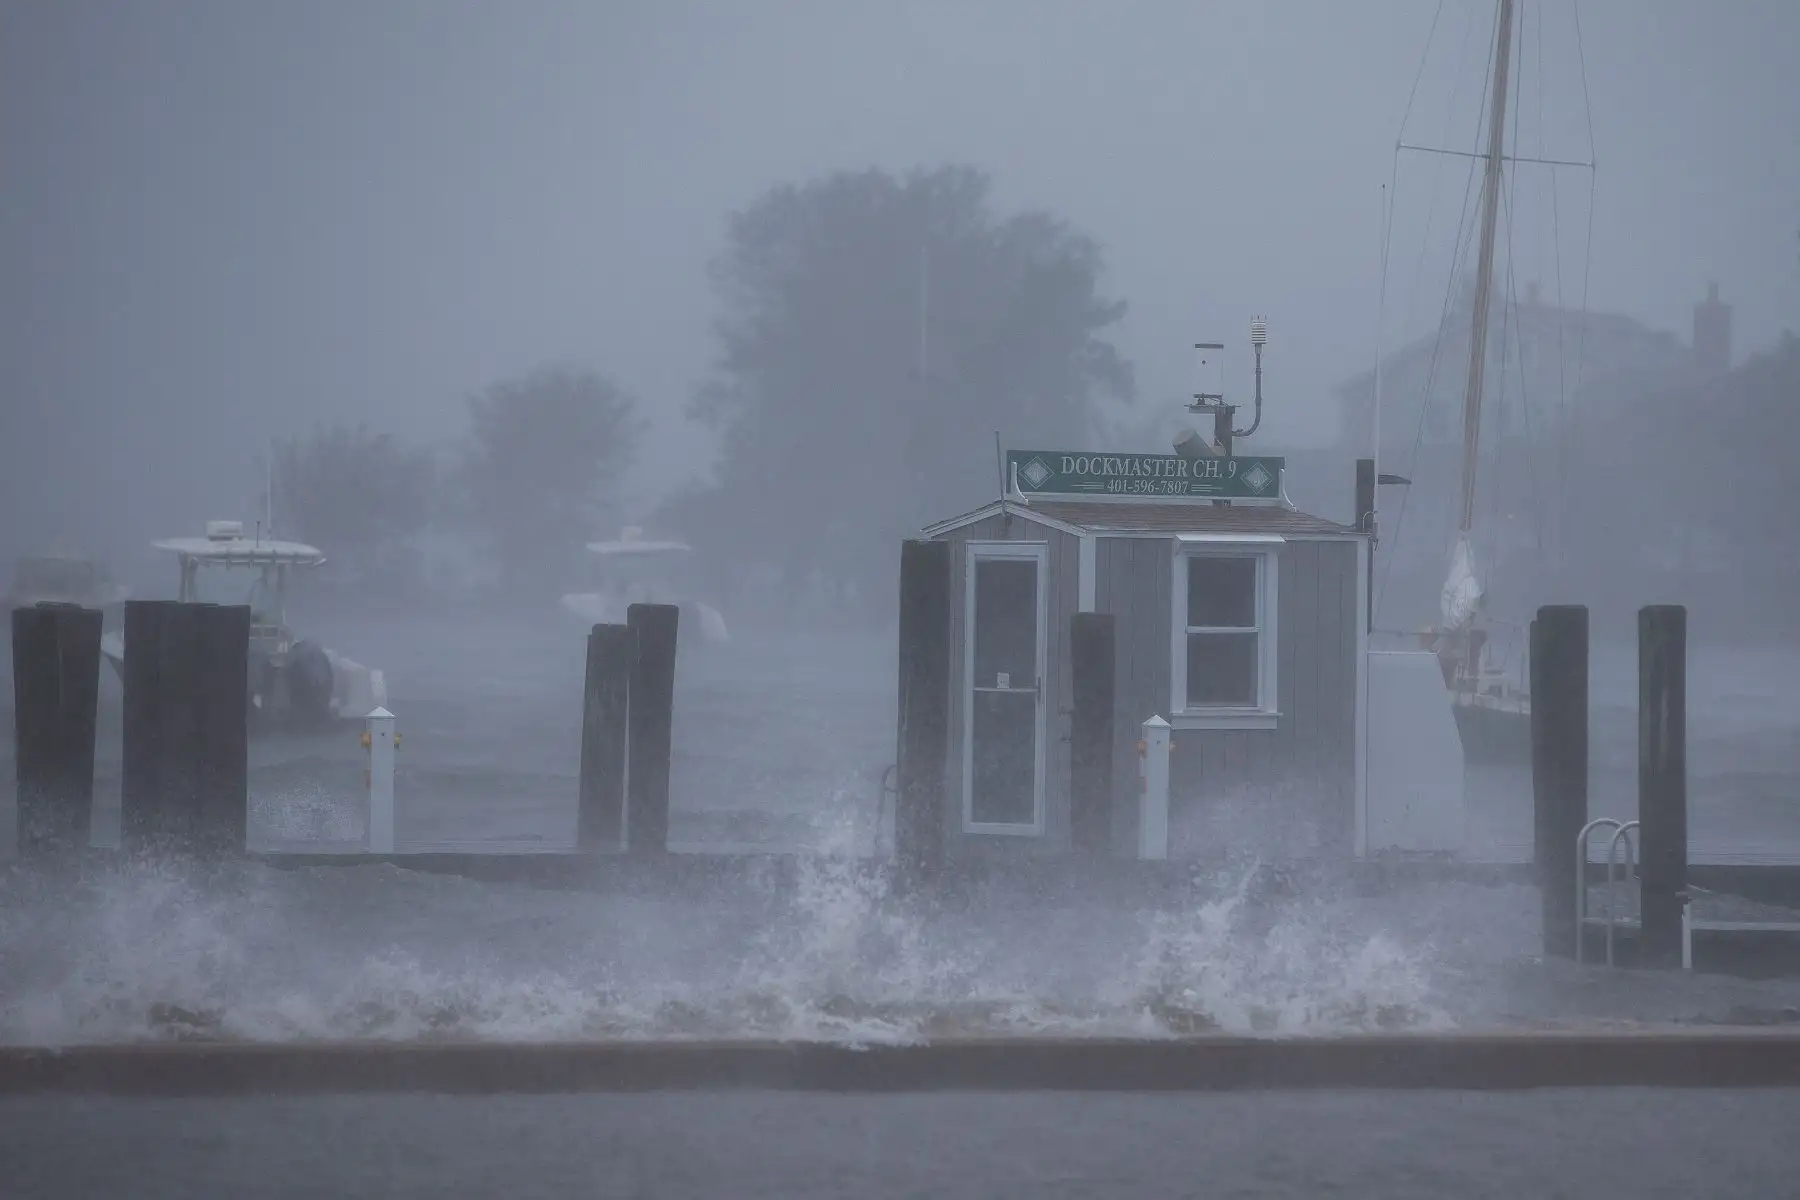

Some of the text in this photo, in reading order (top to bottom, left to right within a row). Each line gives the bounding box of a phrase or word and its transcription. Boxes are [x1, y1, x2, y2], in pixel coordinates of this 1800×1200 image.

[1061, 456, 1237, 479] DOCKMASTER CH. 9
[1107, 479, 1188, 494] 401-596-7807
